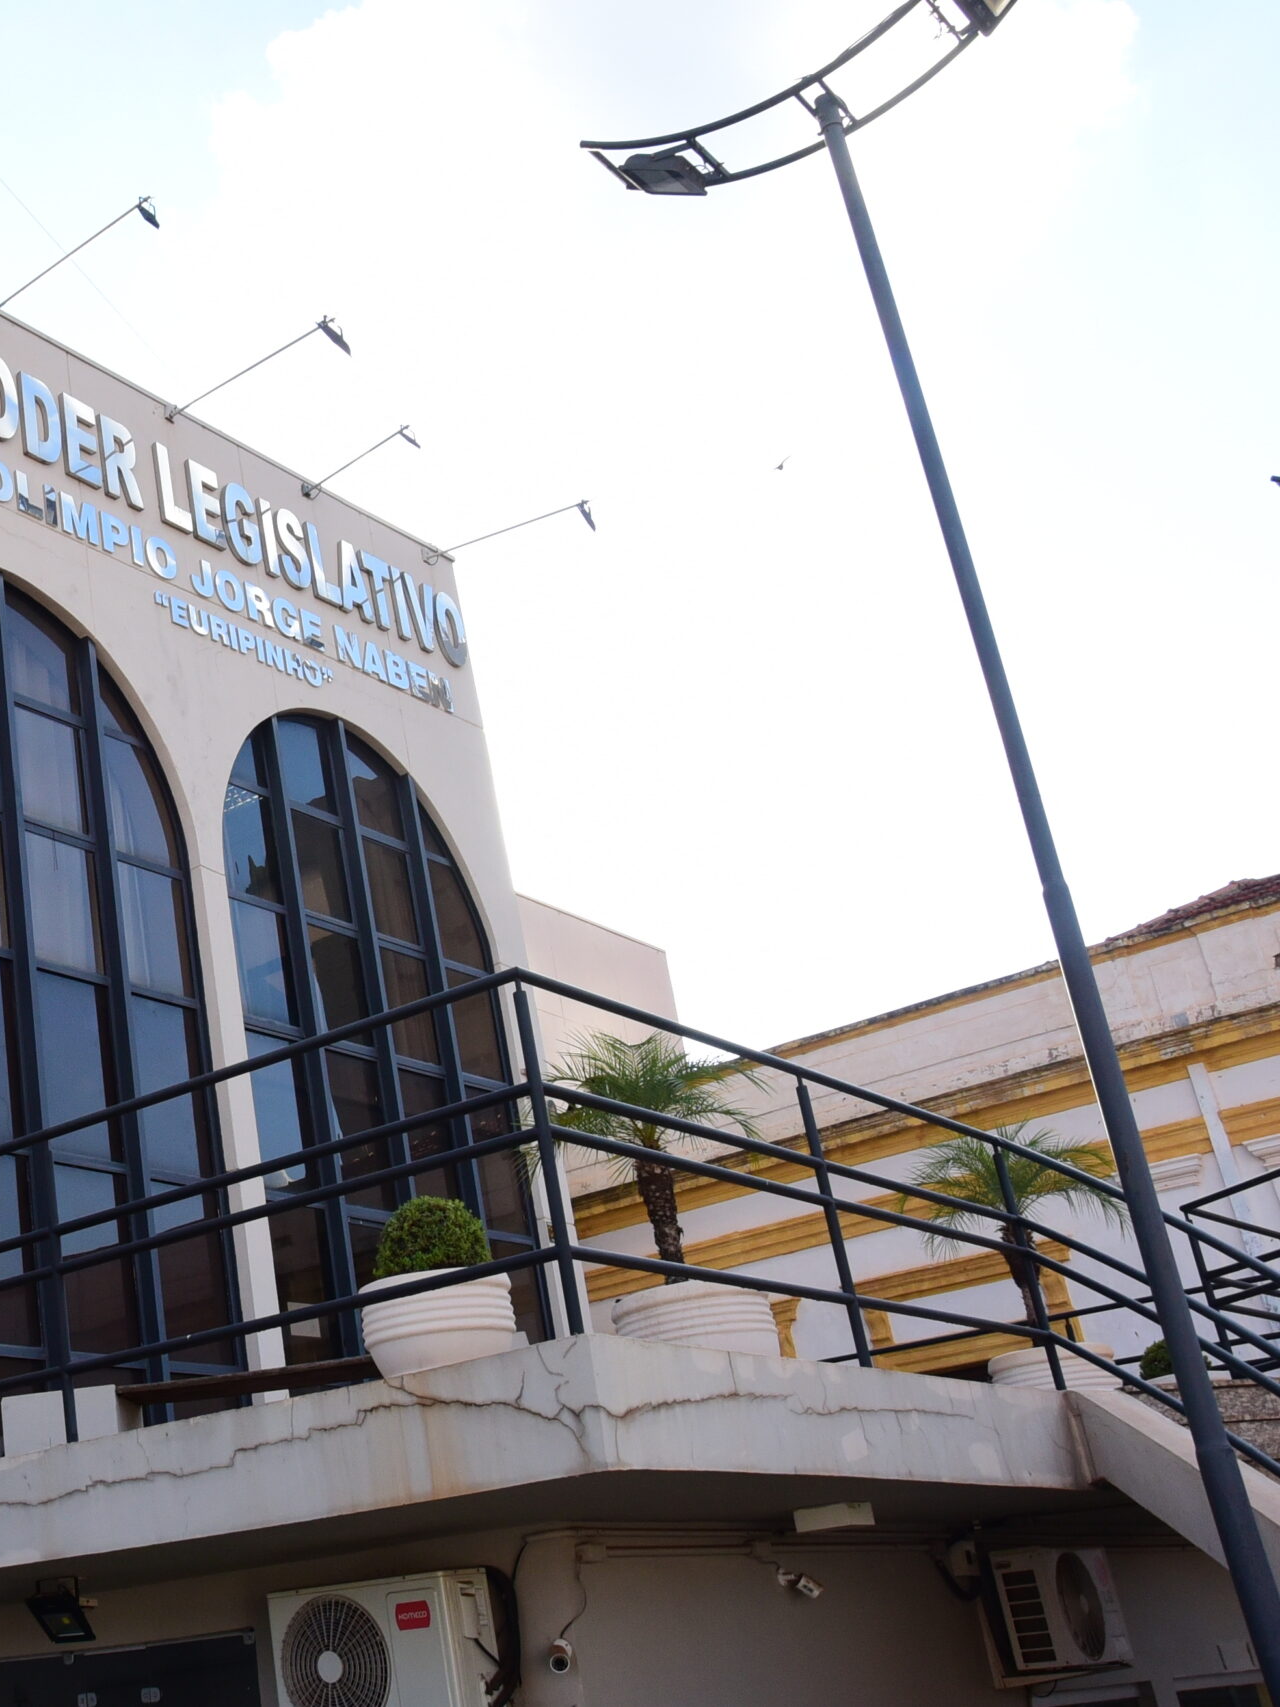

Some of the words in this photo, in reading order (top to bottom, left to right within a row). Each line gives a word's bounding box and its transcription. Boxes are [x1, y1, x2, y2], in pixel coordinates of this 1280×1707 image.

[152, 441, 468, 668] LEGISLATIVO
[190, 559, 325, 652] JORGE
[332, 624, 454, 714] NABEN
